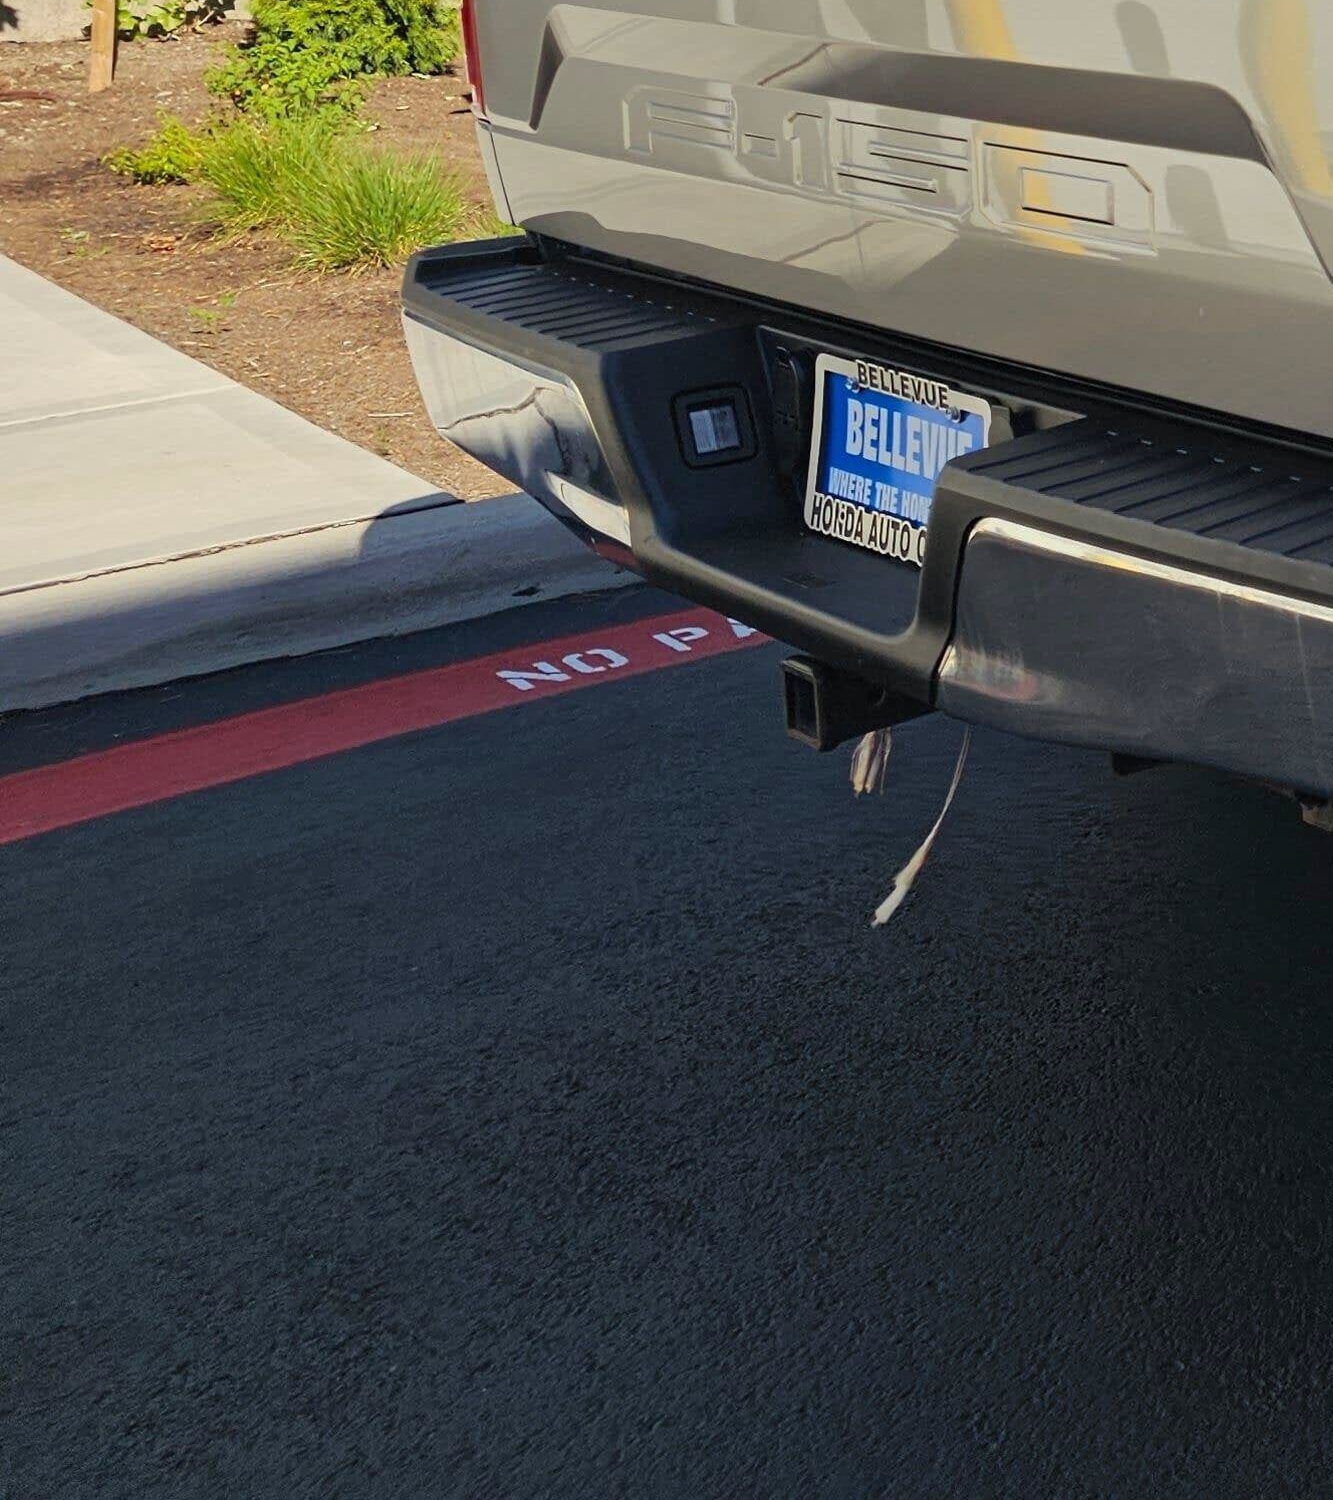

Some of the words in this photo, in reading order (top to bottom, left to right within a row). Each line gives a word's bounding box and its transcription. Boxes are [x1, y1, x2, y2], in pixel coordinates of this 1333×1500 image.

[621, 84, 1158, 258] F-150
[856, 363, 950, 410] BELLEVUE
[828, 466, 873, 505] WHERE
[874, 481, 899, 513] THE
[810, 493, 864, 544] HONDA
[867, 512, 911, 559] AUTO
[495, 647, 630, 692] NO
